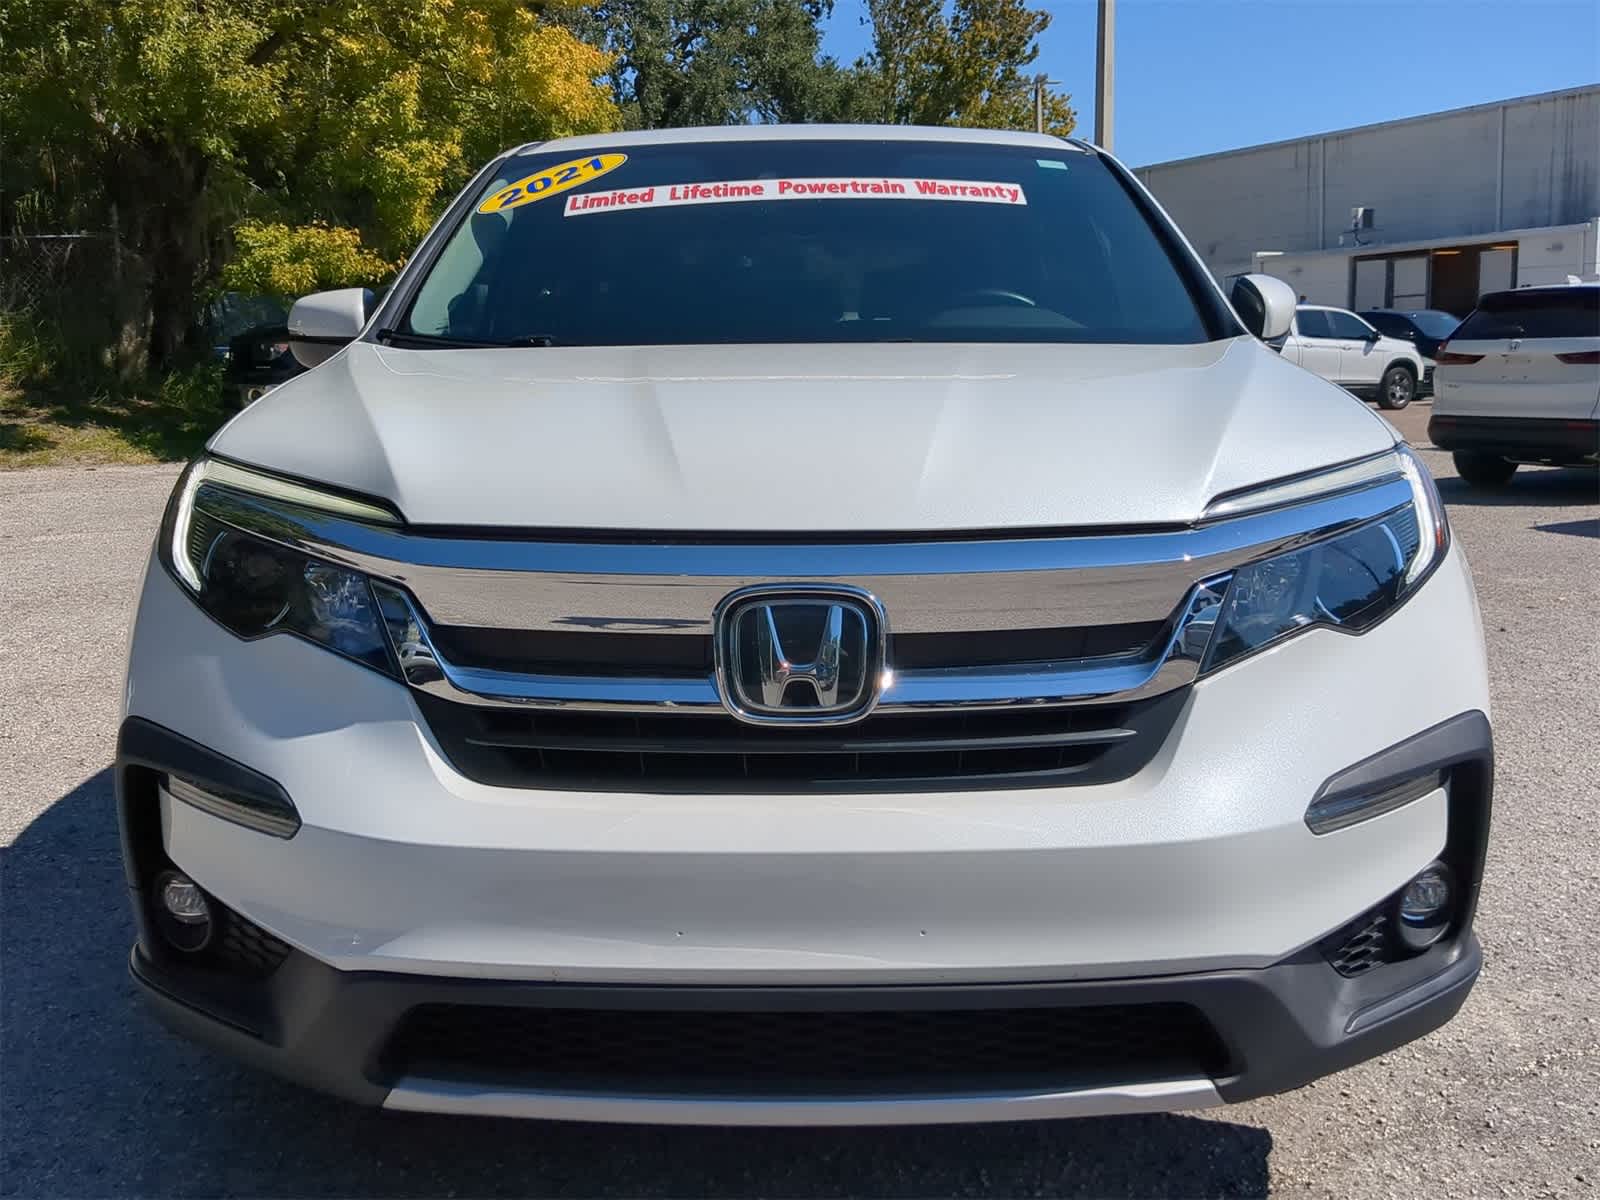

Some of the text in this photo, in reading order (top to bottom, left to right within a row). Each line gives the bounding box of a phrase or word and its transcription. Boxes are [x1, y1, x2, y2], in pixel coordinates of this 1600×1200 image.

[497, 157, 604, 208] 2021
[569, 180, 1019, 212] Limited Lifetime Powertrain Warranty
